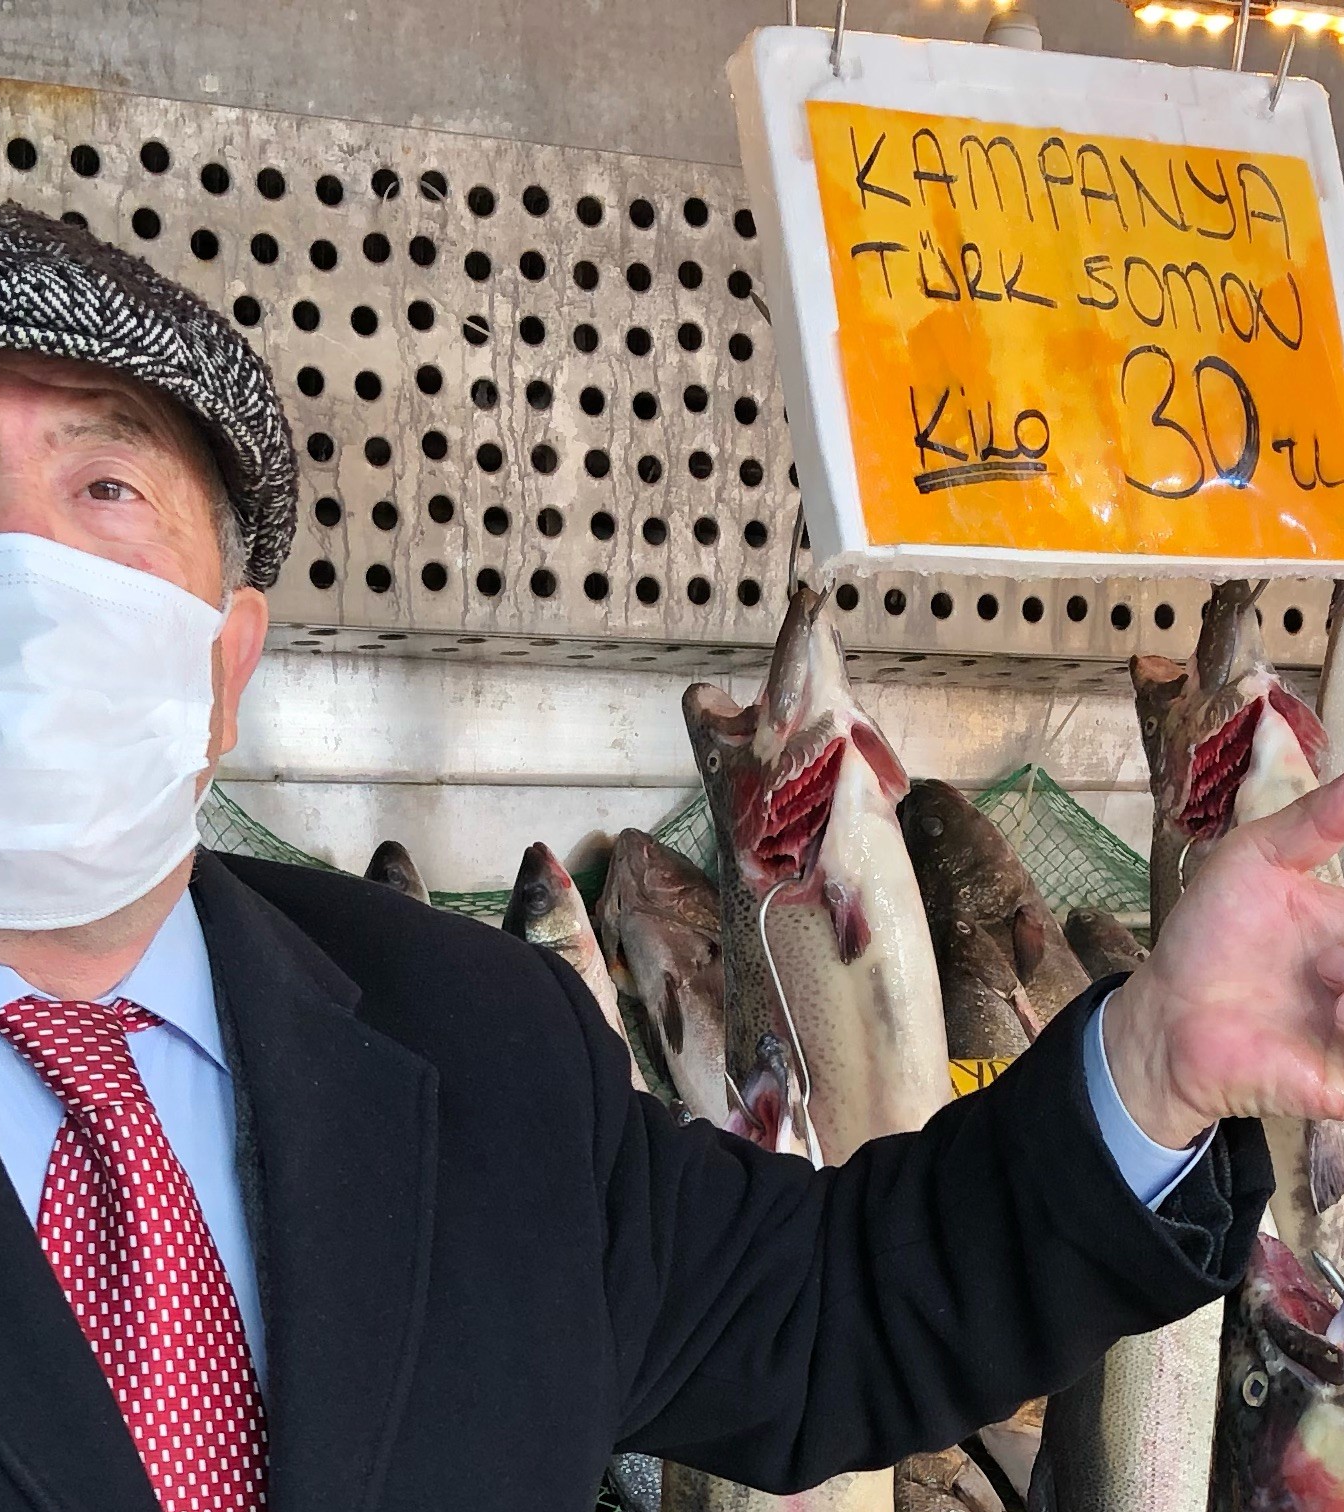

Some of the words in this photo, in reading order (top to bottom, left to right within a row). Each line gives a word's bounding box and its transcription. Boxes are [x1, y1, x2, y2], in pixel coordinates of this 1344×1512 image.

[849, 126, 1292, 259] KAMPANYA
[851, 230, 1058, 308] TÜRK
[1120, 344, 1260, 499] 30
